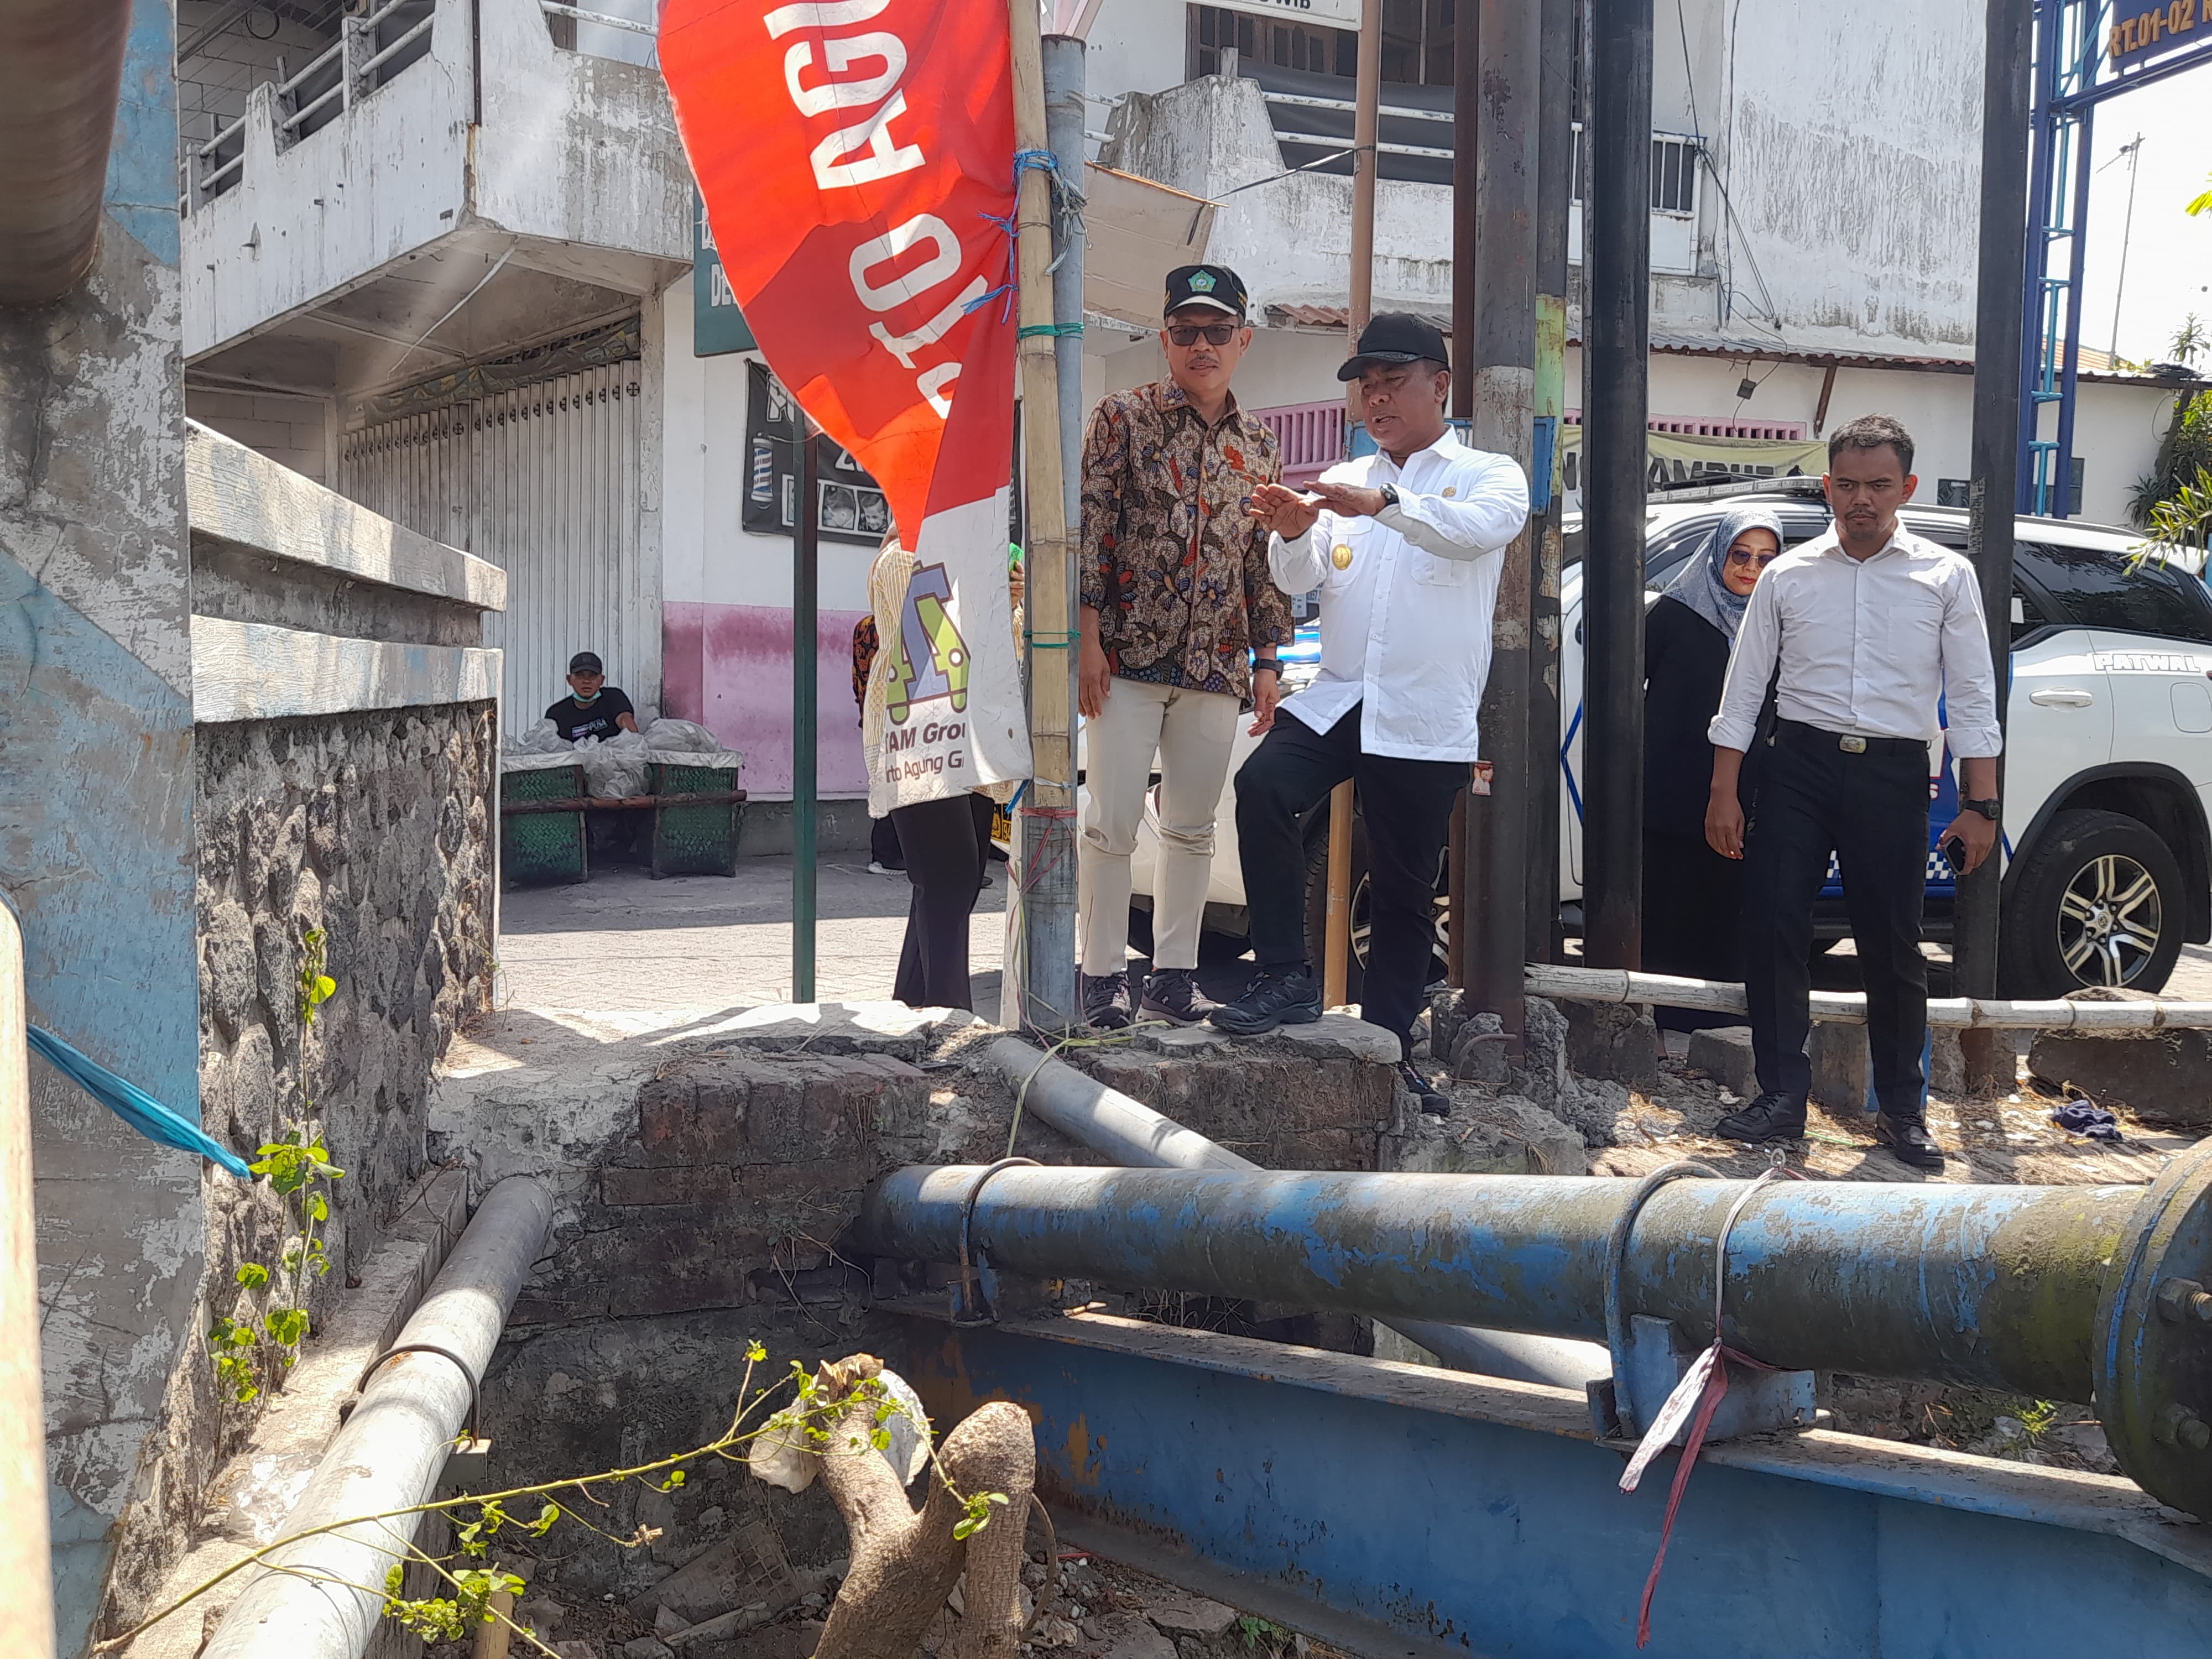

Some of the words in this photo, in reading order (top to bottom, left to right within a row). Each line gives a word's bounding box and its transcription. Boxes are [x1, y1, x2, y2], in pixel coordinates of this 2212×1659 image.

[2109, 0, 2195, 58] RT.01-02
[2092, 653, 2201, 673] PATWAL
[904, 755, 944, 781] Agung
